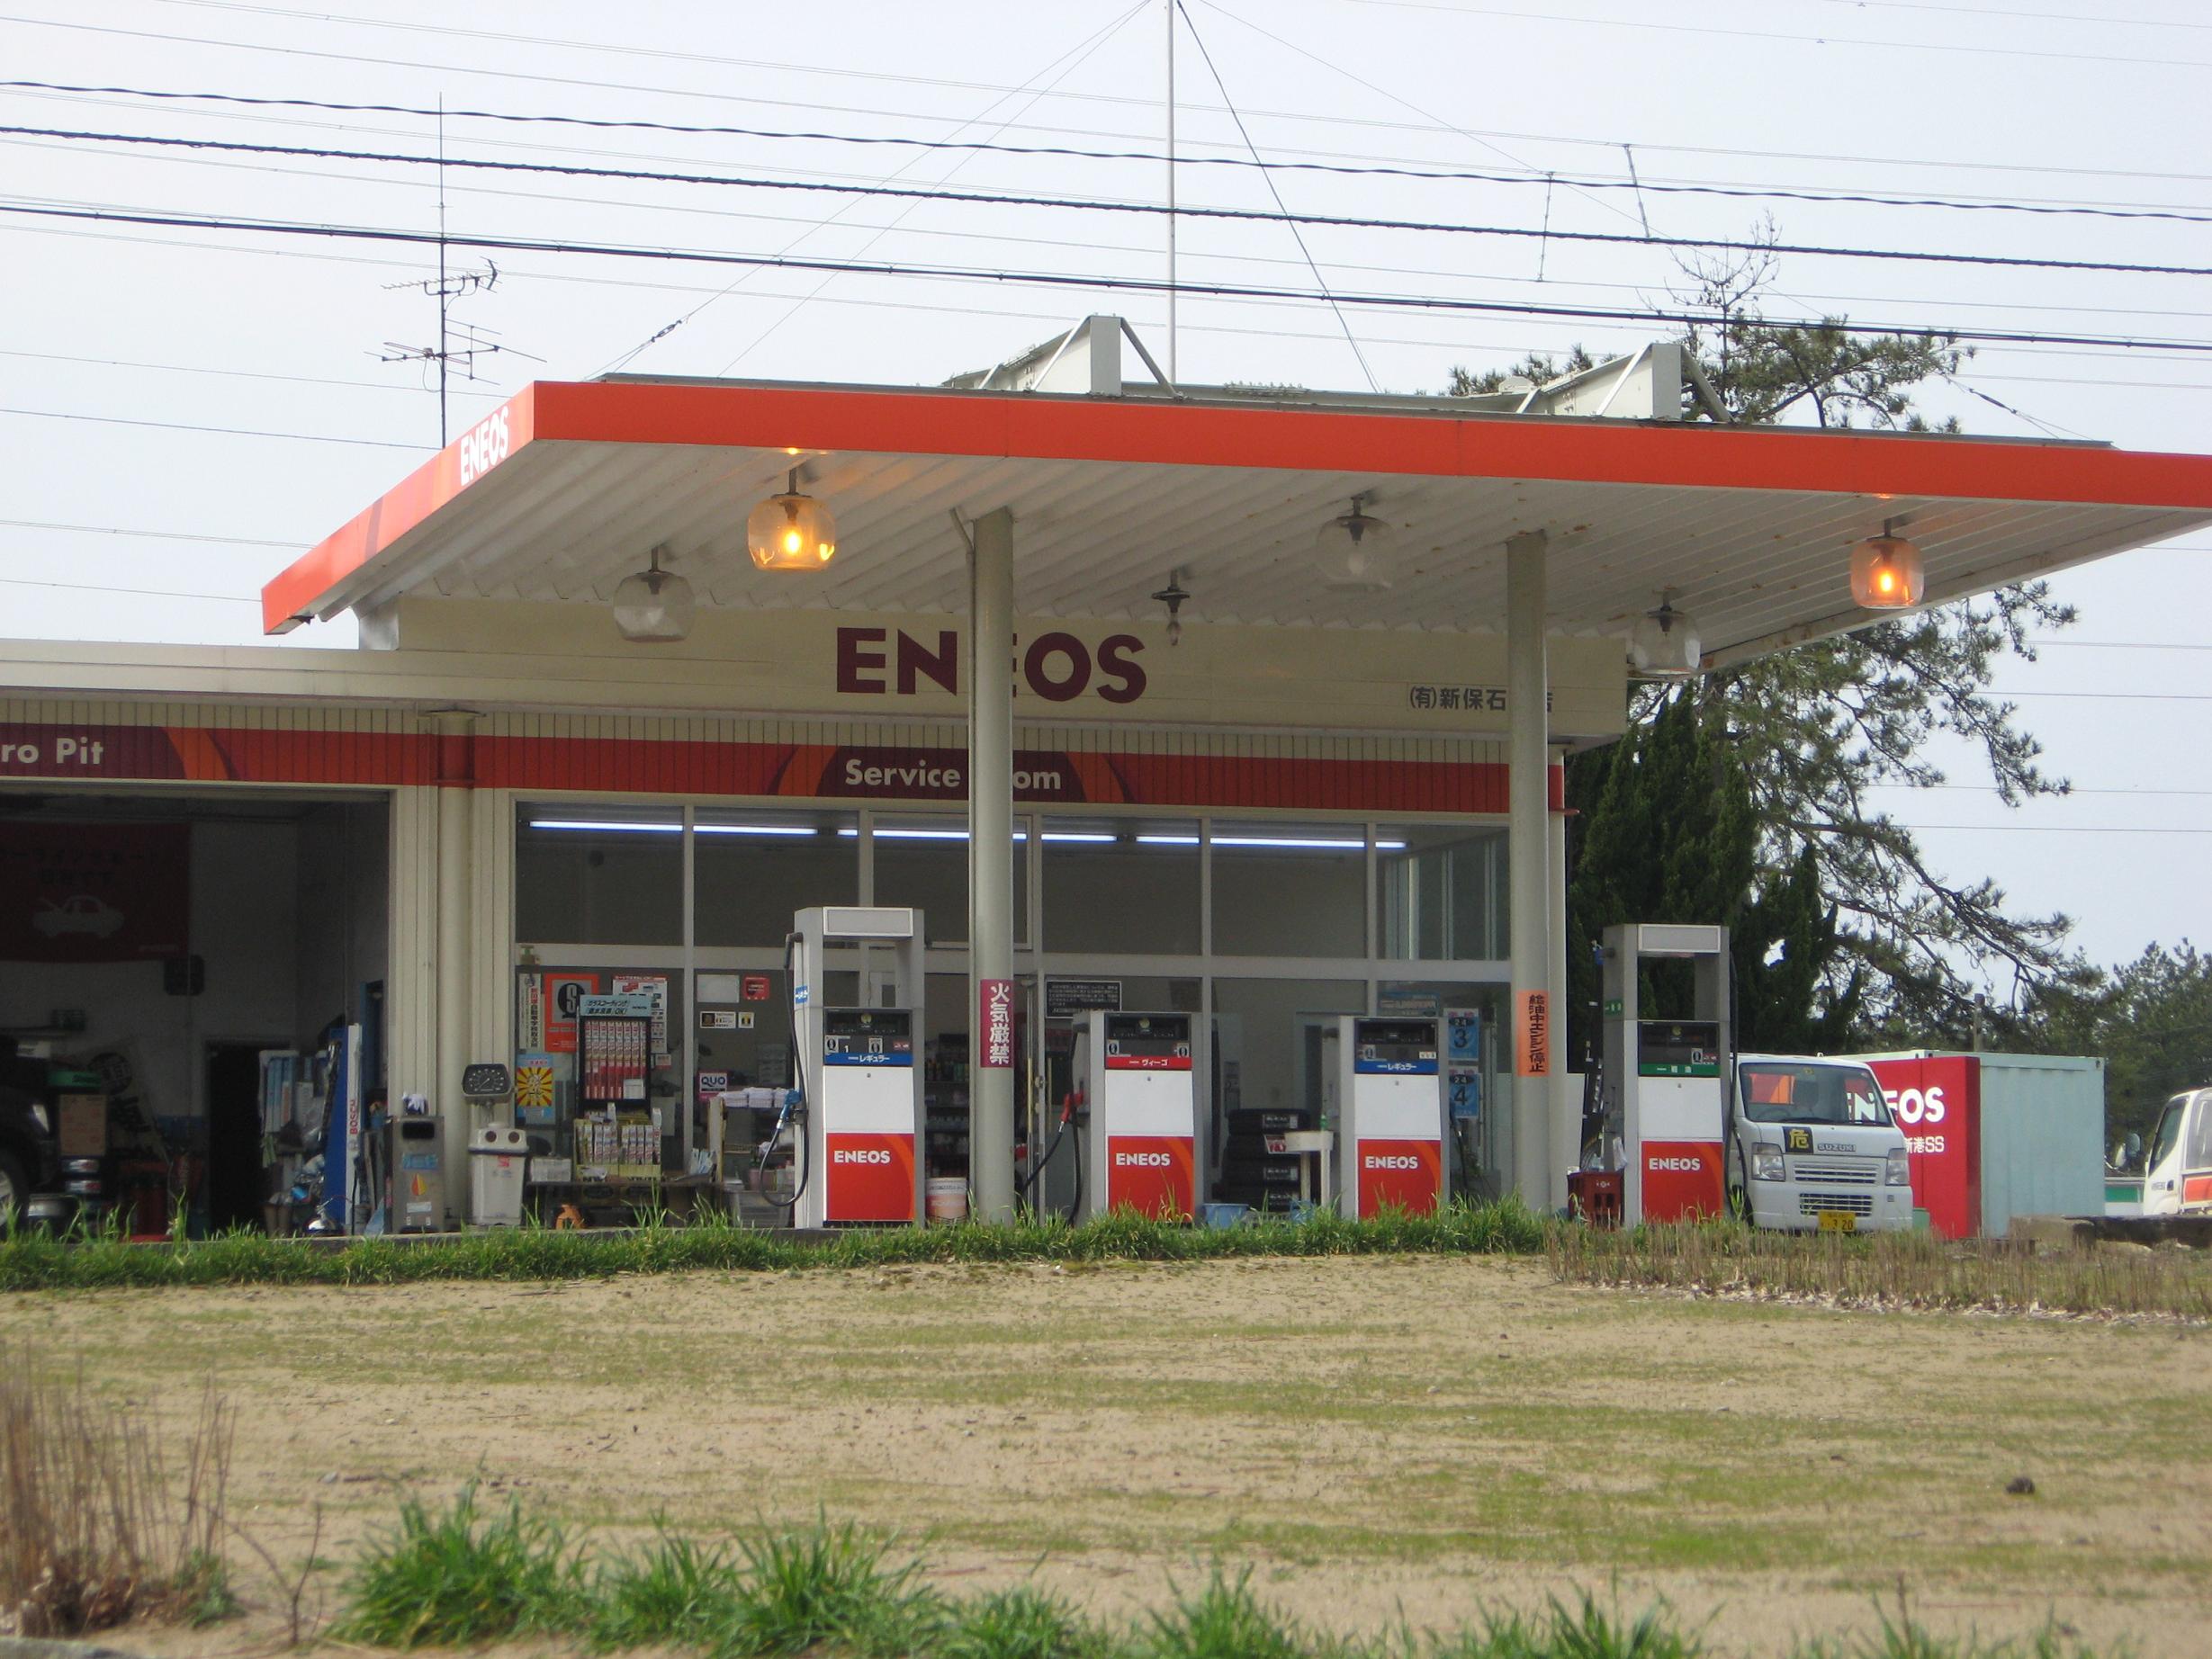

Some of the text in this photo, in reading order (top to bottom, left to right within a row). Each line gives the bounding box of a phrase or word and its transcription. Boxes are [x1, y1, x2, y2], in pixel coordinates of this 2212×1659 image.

[460, 406, 509, 487] ENEOS
[837, 626, 1147, 704] ENOS
[1410, 686, 1554, 713] (有)新保石
[56, 736, 104, 765] Pit
[845, 758, 1062, 790] Service om
[990, 982, 1010, 1065] 火気厳禁
[1528, 993, 1545, 1072] 給油中エンジン停止
[1453, 1027, 1469, 1048] 3
[1141, 1057, 1168, 1067] ヴィーゴ
[701, 1076, 726, 1088] QUO
[1453, 1085, 1468, 1106] 4
[1847, 1087, 1945, 1124] NOS
[1789, 1128, 1810, 1150] 危
[833, 1150, 891, 1164] ENEOS
[1116, 1152, 1171, 1167] ENEOS
[1364, 1155, 1419, 1170] ENEOS
[1648, 1157, 1701, 1170] ENEOS
